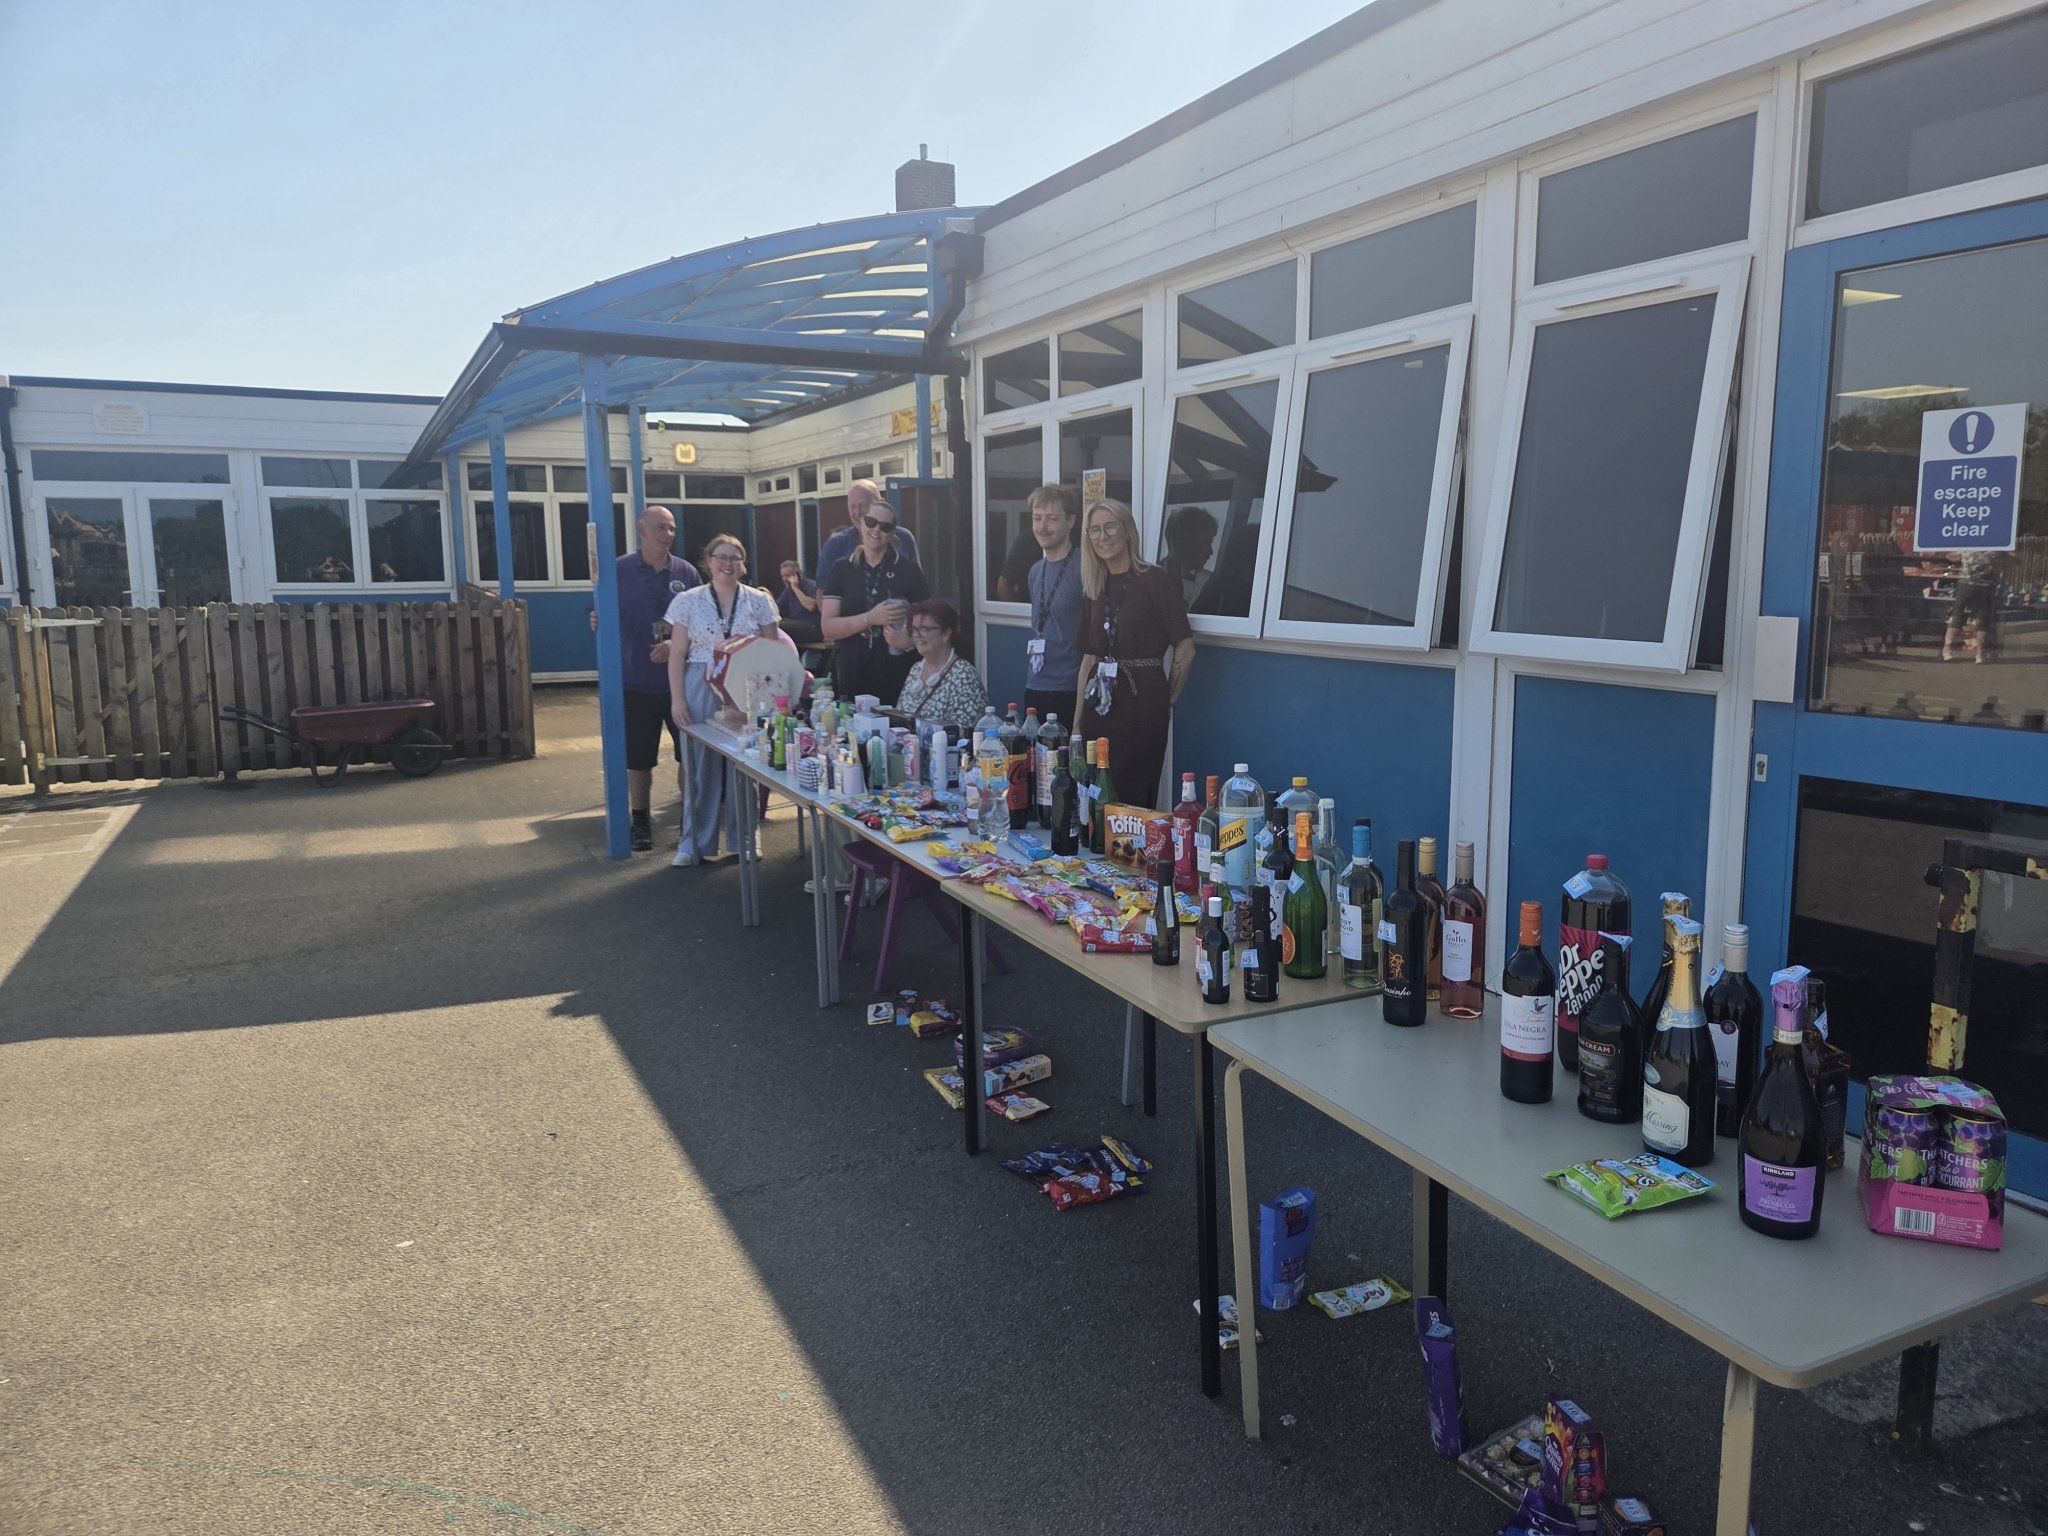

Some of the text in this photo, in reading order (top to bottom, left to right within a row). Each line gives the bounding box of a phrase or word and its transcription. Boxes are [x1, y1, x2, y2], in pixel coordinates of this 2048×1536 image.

[1951, 465, 1987, 480] Fire
[1934, 486, 2002, 502] escape
[1942, 503, 1991, 521] Keep
[1941, 522, 1989, 537] clear
[1107, 814, 1147, 835] Toffif
[1219, 823, 1244, 845] eppes
[1445, 934, 1467, 943] Gallo
[1560, 942, 1581, 975] Dr
[1559, 948, 1605, 999] eppe
[1519, 1024, 1547, 1034] NEGRA
[1585, 1041, 1611, 1054] CREAM
[1763, 1166, 1795, 1177] KIRKLAND
[1760, 1197, 1795, 1209] PROSECCO
